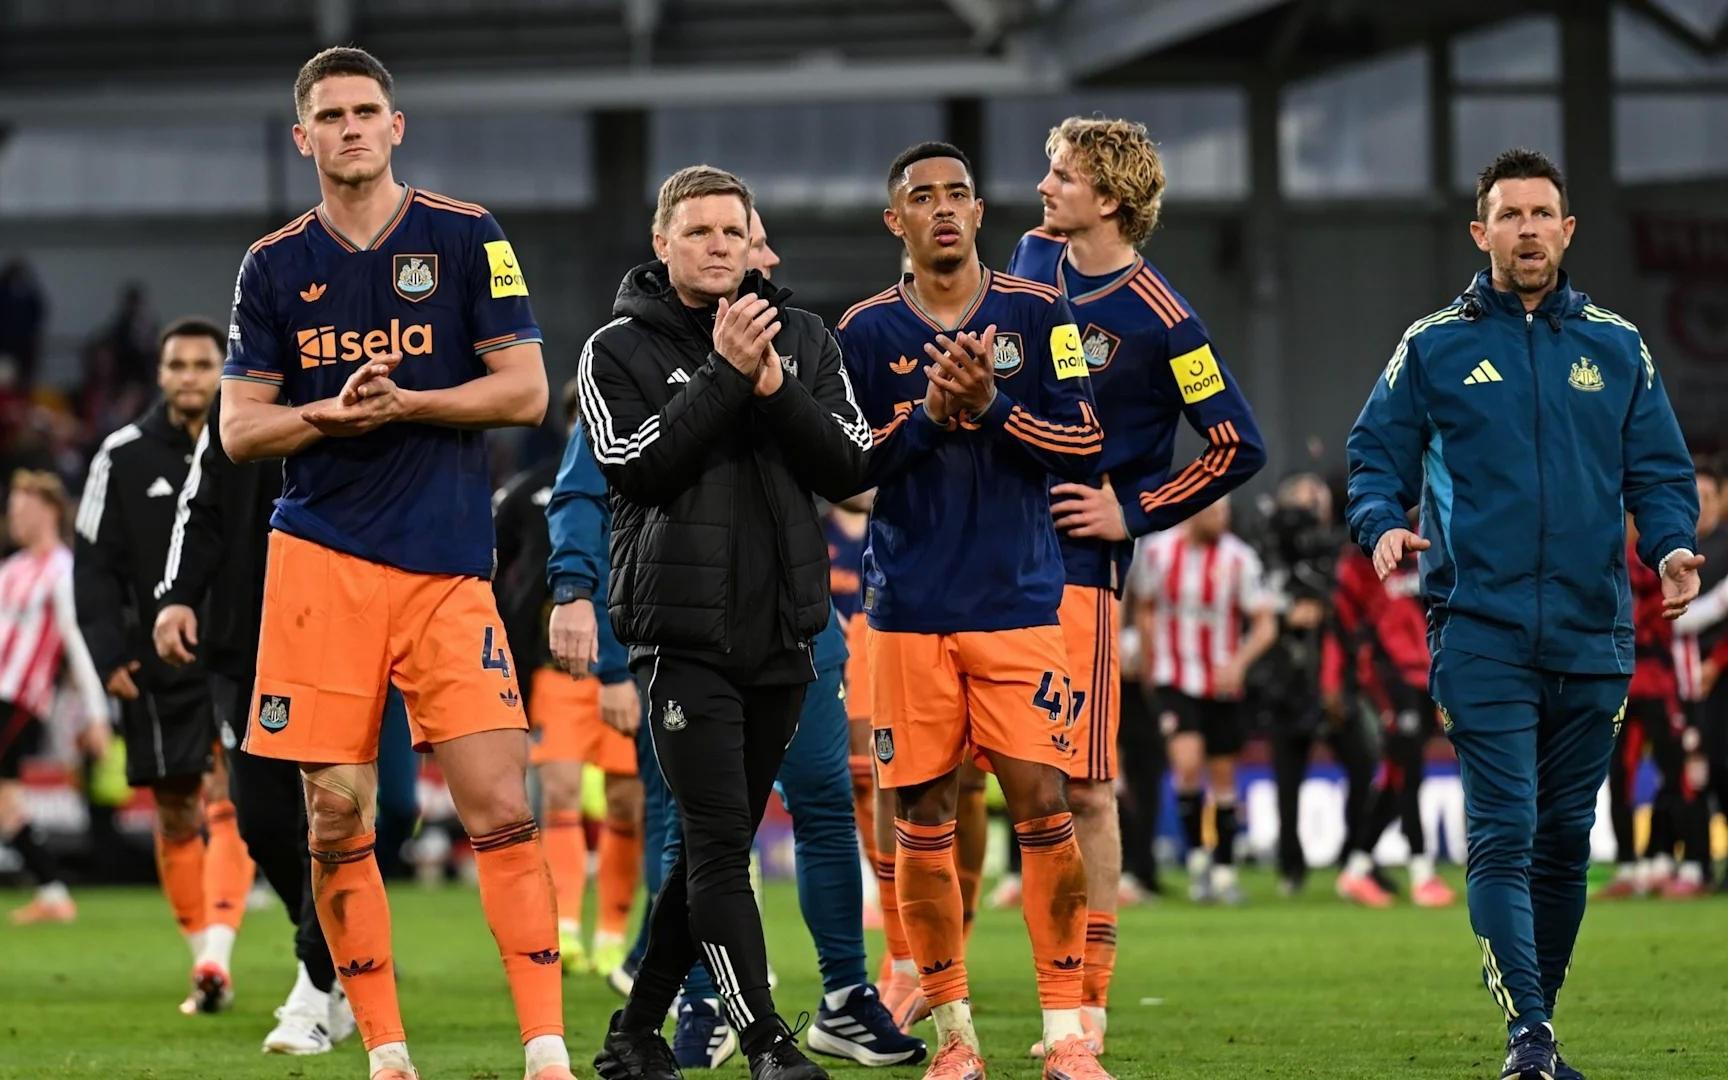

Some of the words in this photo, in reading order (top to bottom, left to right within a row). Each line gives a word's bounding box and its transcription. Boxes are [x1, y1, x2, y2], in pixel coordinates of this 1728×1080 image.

[340, 318, 433, 361] sela
[1057, 356, 1085, 370] non
[1183, 373, 1219, 395] noon
[482, 626, 509, 678] 4
